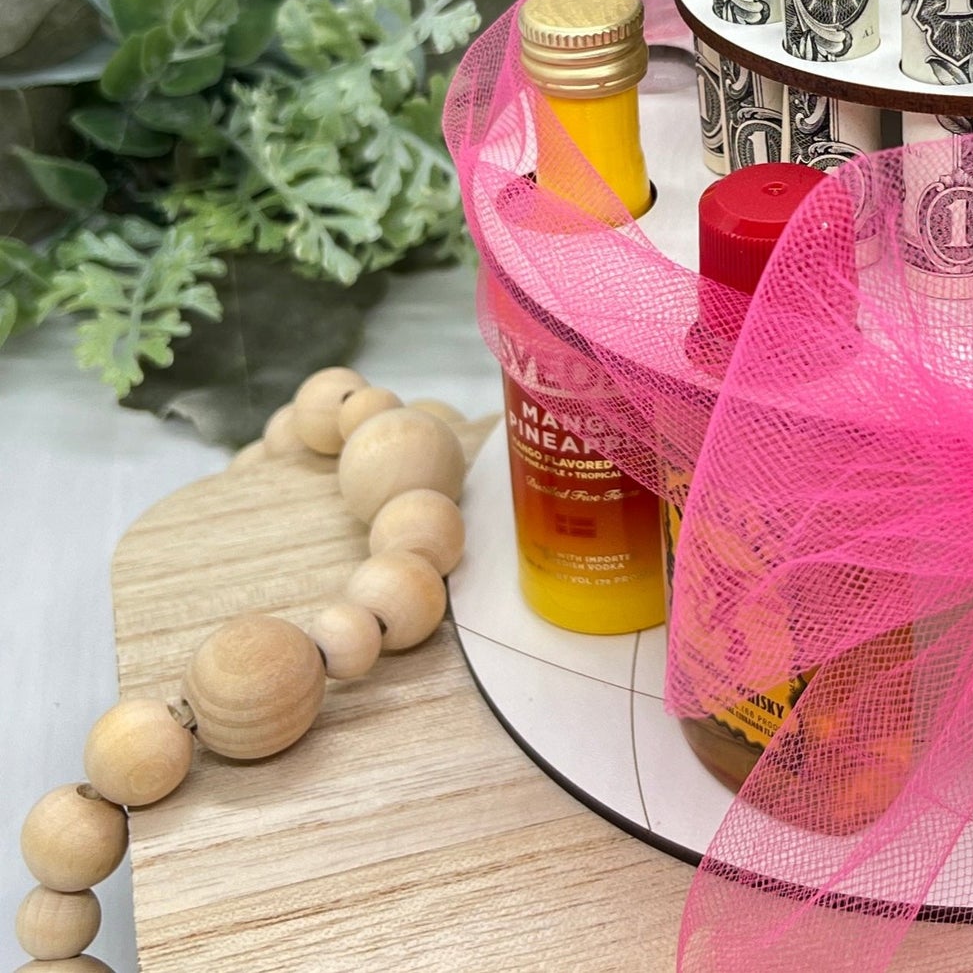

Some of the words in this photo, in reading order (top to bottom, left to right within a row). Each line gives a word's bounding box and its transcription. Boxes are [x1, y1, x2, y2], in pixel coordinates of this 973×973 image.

[945, 198, 972, 247] 1
[521, 400, 605, 433] MANG
[543, 454, 614, 470] FLAVORED
